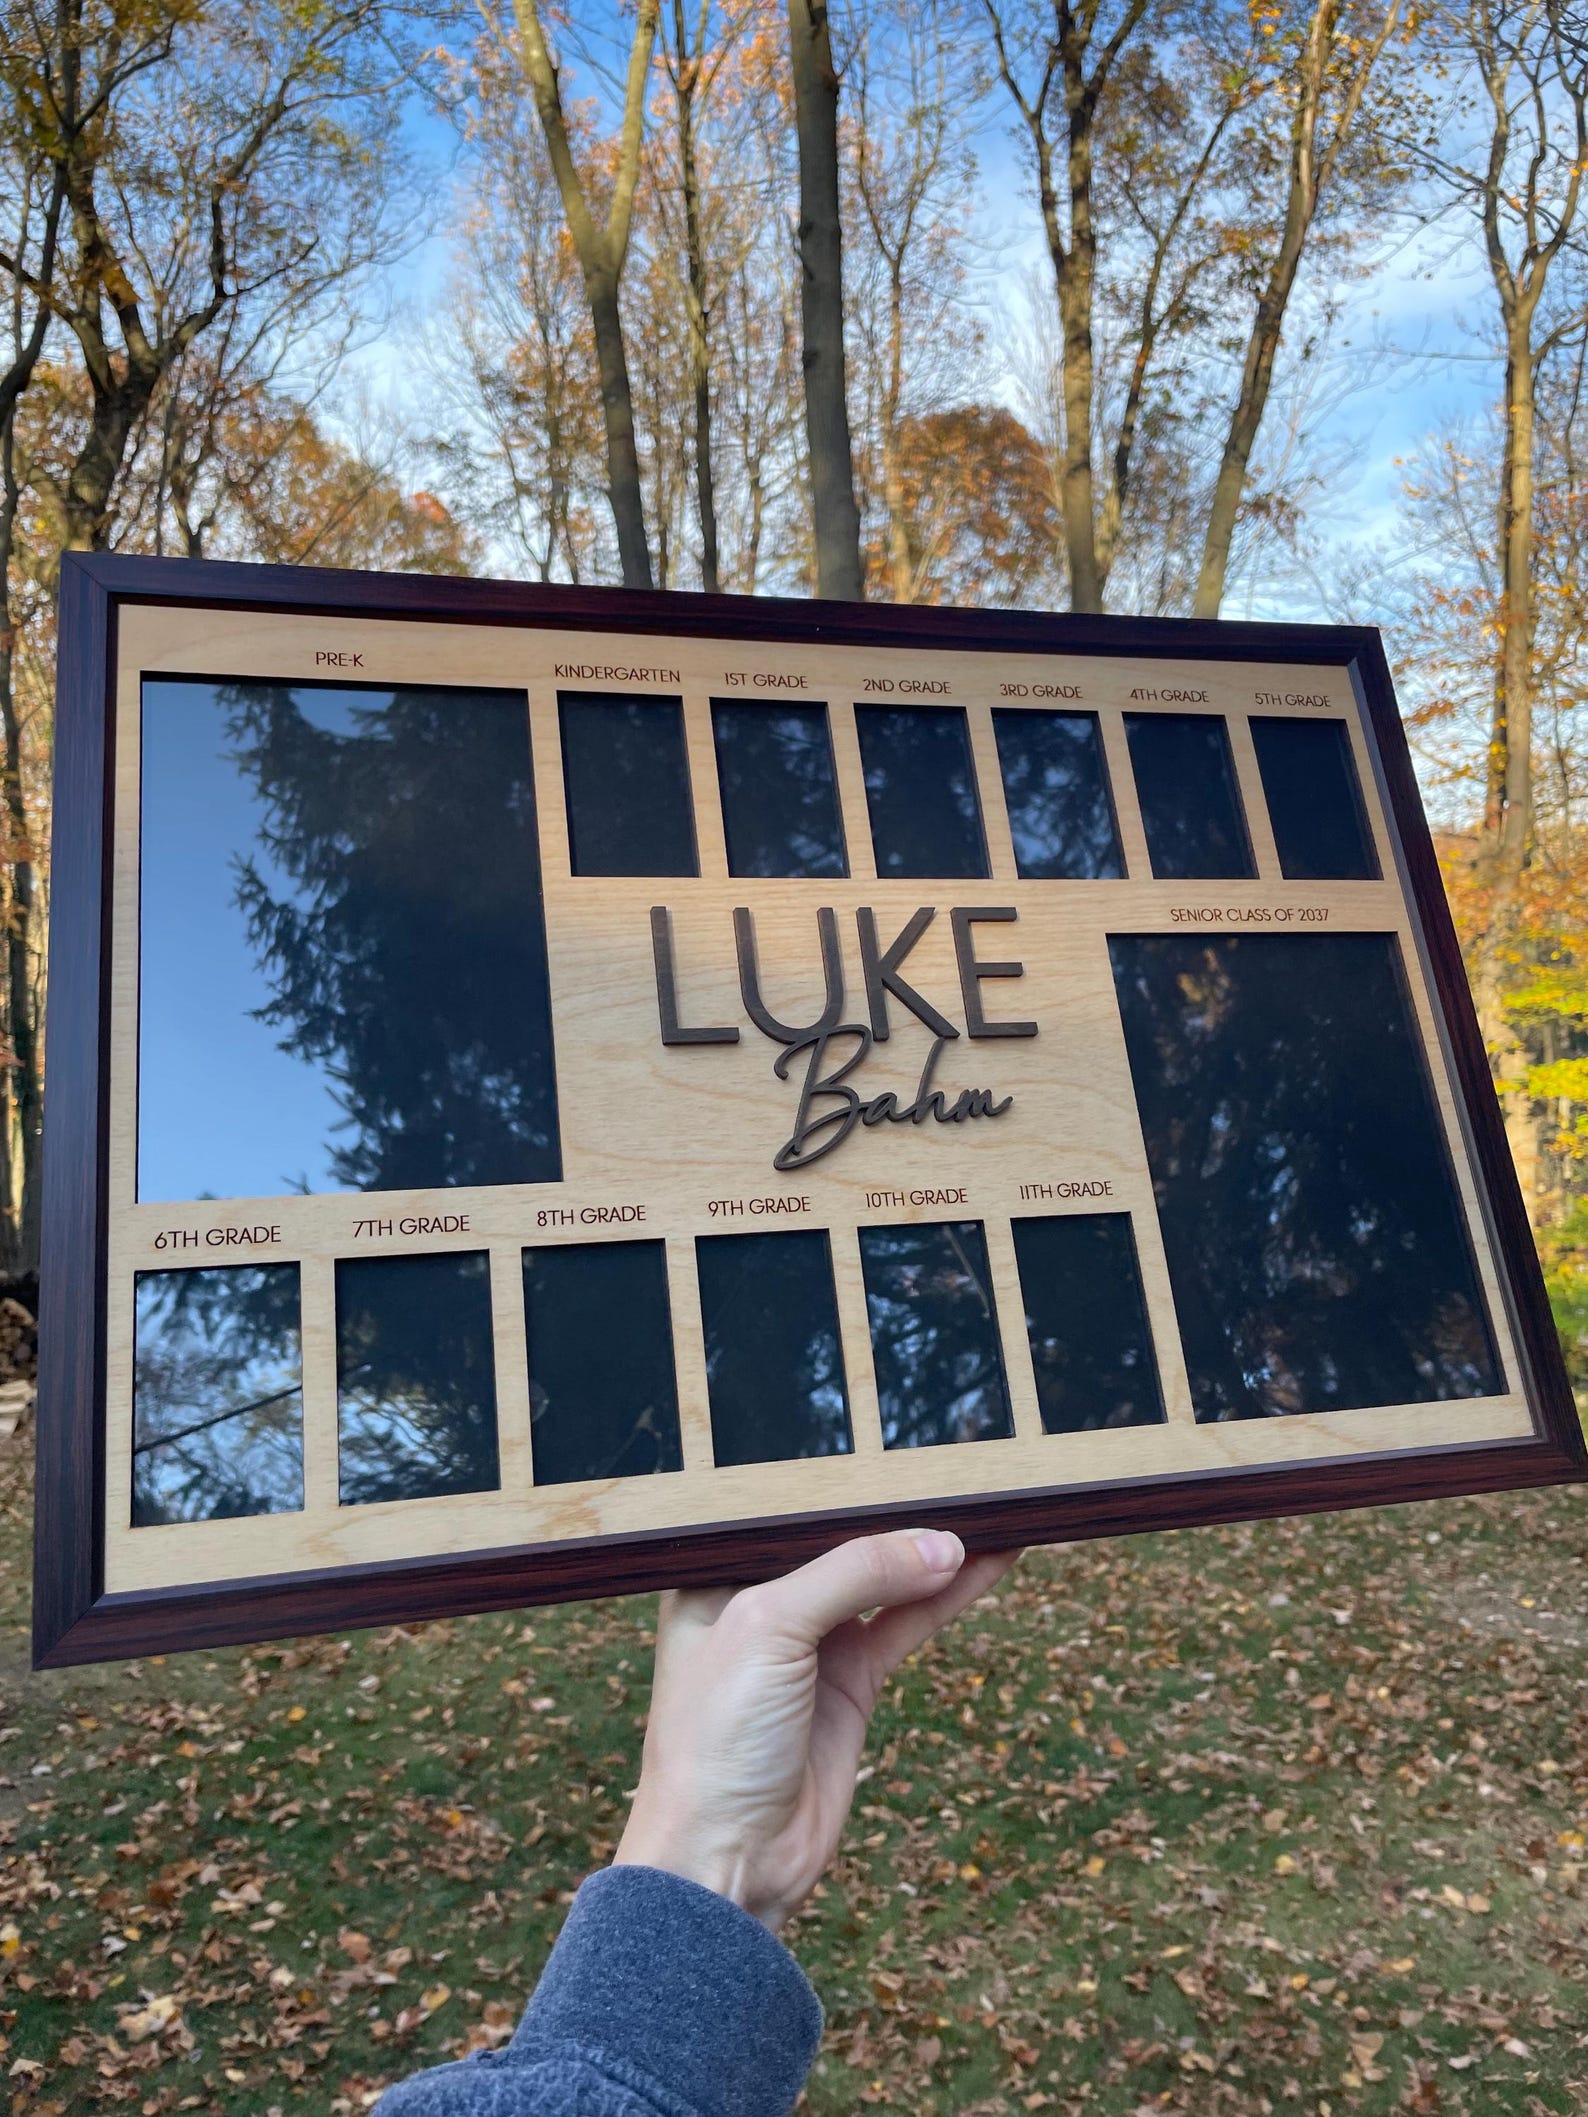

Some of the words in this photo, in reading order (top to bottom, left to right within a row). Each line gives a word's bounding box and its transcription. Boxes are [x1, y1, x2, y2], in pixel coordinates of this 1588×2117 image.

[315, 651, 365, 668] PRE-K
[554, 663, 681, 683] KINDERGARTEN
[724, 672, 748, 686] 1ST
[752, 673, 809, 689] GRADE
[863, 678, 895, 693] 2ND
[898, 679, 952, 695] GRADE
[999, 683, 1029, 697] 3RD
[1032, 684, 1084, 699] GRADE
[1130, 688, 1160, 701] 4TH
[1162, 689, 1210, 703] GRADE
[1255, 692, 1282, 706] 5TH
[1284, 693, 1331, 708] GRADE
[1170, 908, 1223, 922] SENIOR
[1226, 908, 1271, 922] CLASS
[1274, 908, 1294, 922] OF
[1297, 908, 1329, 922] 2037
[650, 906, 1039, 1046] LUKE
[773, 1023, 1014, 1171] Bahm
[865, 1191, 905, 1209] 10TH
[909, 1187, 969, 1206] GRADE
[1019, 1183, 1055, 1201] 11TH
[1058, 1180, 1114, 1199] GRADE
[536, 1209, 575, 1228] 8TH
[579, 1204, 647, 1225] GRADE
[707, 1199, 744, 1218] 9TH
[748, 1195, 812, 1215] GRADE
[352, 1219, 393, 1239] 7TH
[399, 1214, 471, 1236] GRADE
[154, 1230, 199, 1250] 6TH
[205, 1225, 282, 1247] GRADE
